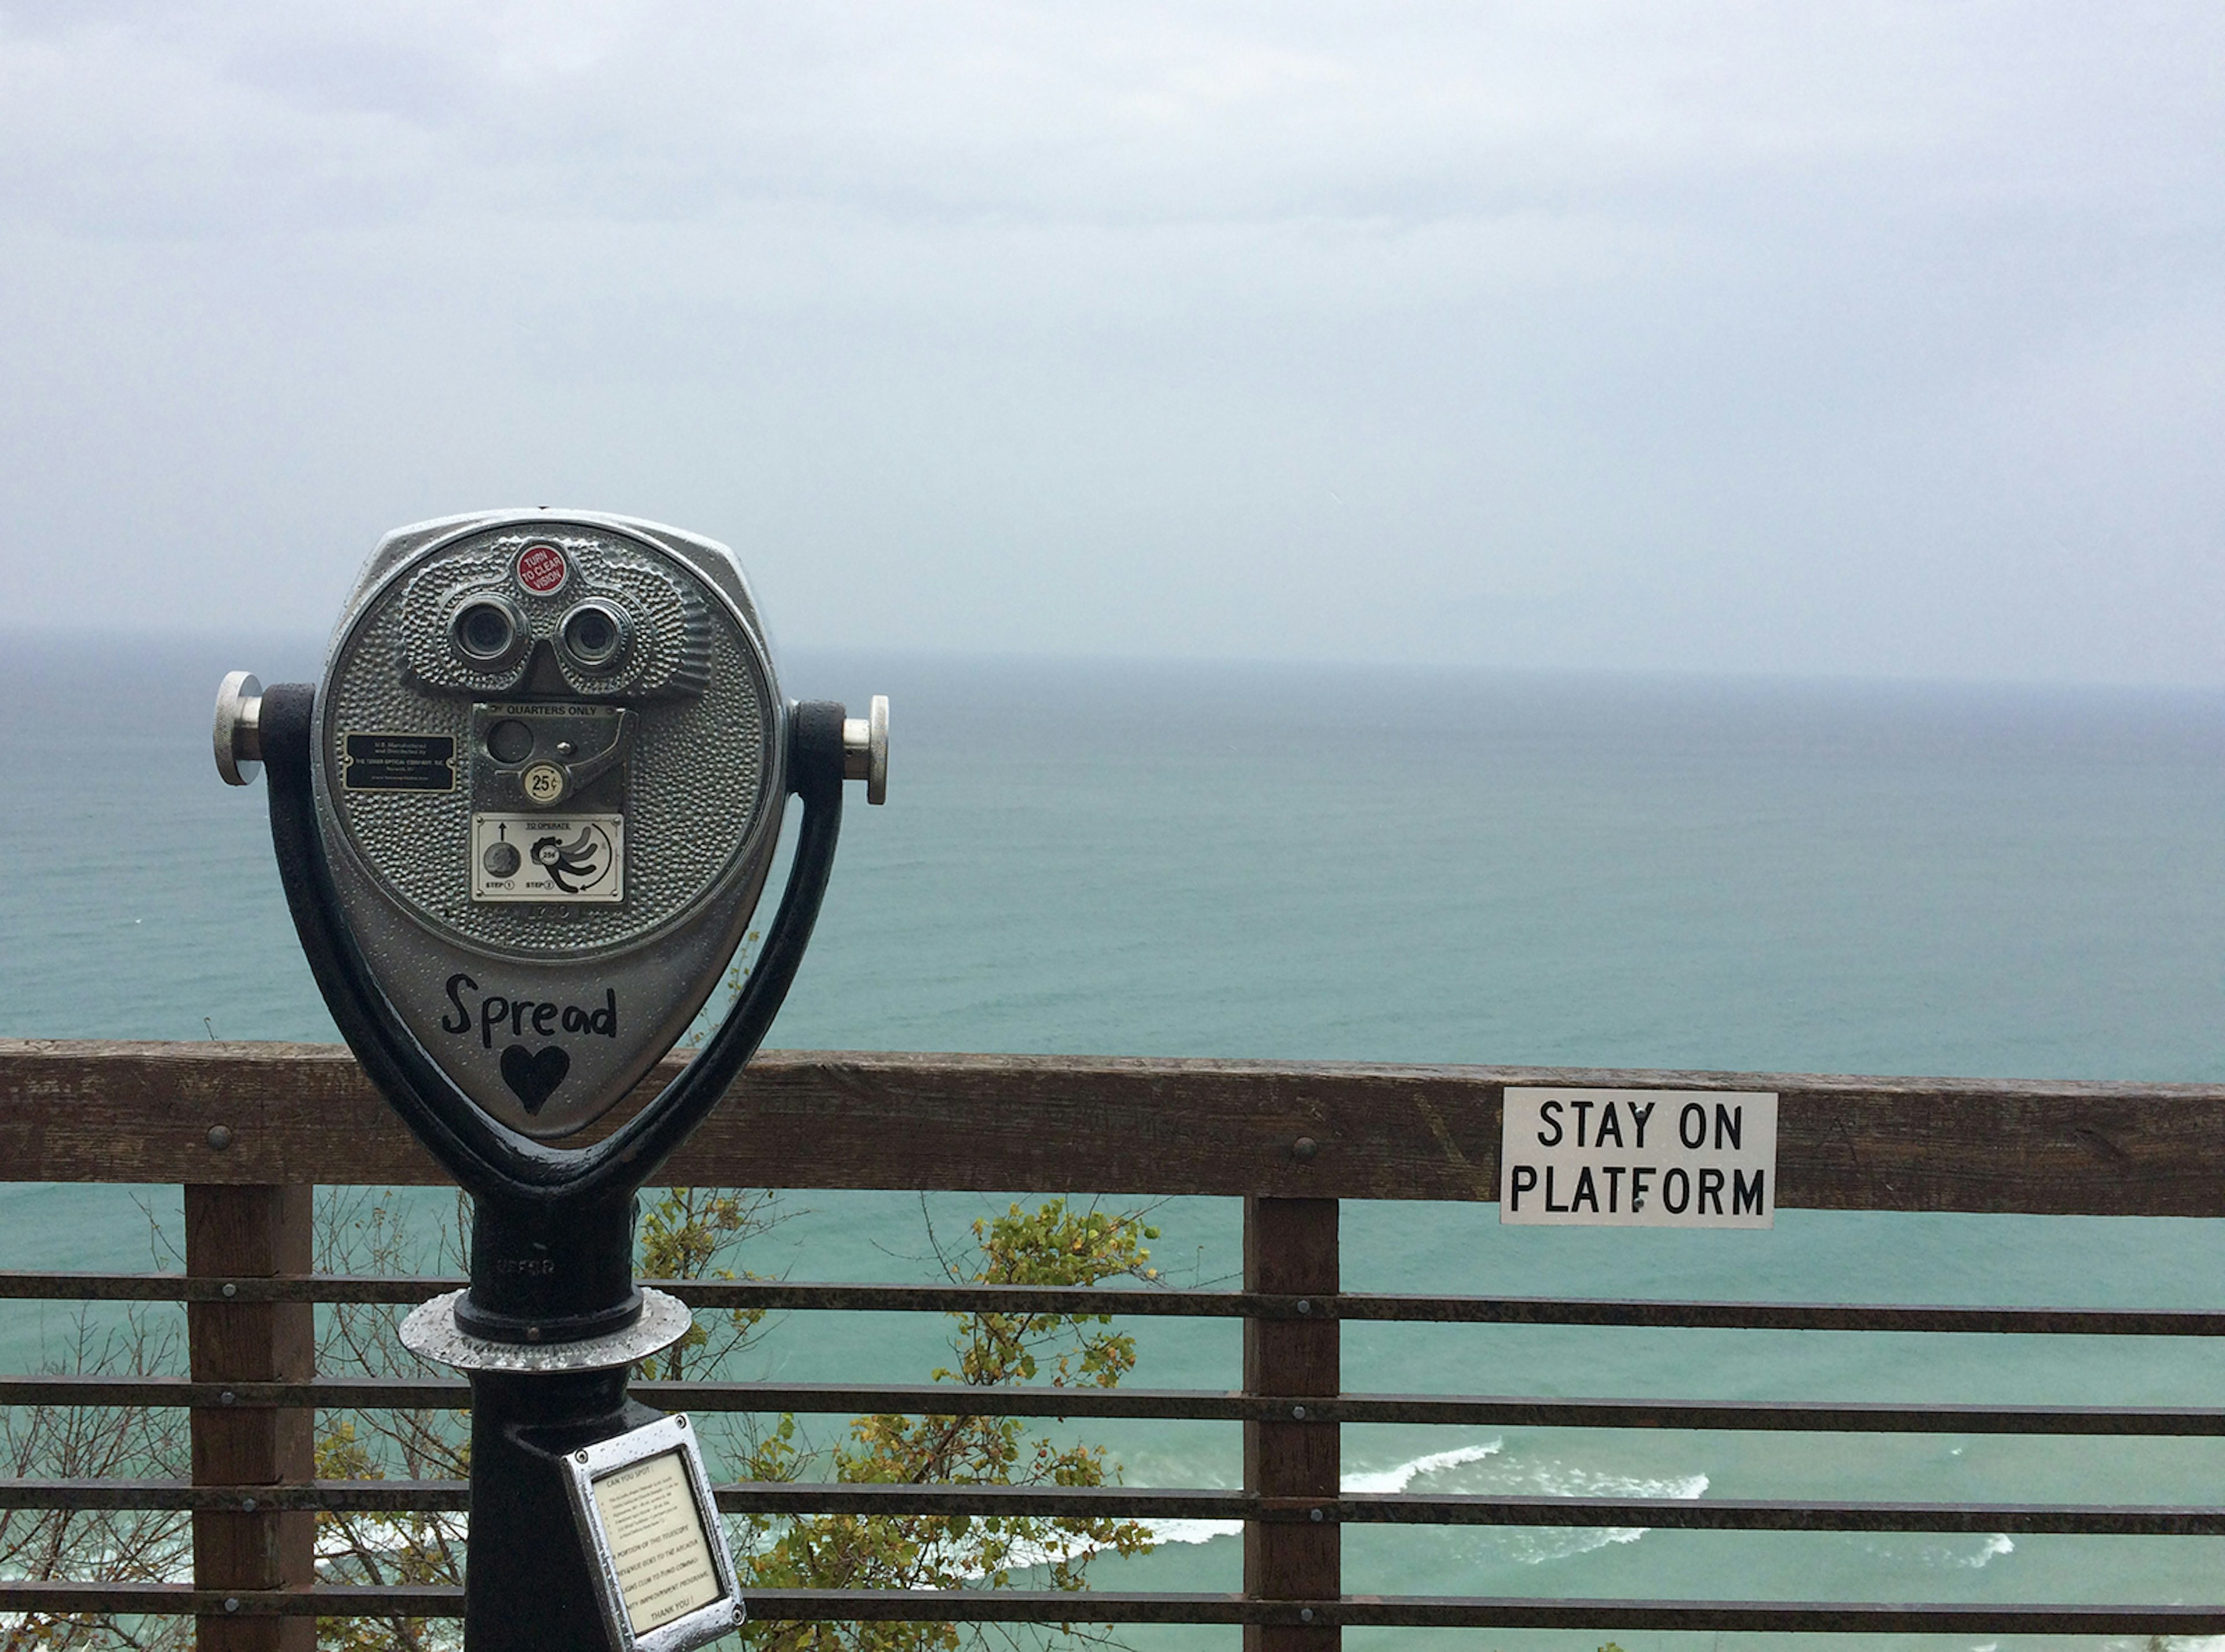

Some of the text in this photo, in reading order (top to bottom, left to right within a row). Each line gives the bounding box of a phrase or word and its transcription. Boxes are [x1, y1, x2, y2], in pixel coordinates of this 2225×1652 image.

[524, 550, 548, 567] TURN
[522, 557, 562, 582] TO CLEAR
[533, 570, 561, 589] VISION
[507, 706, 597, 715] QUARTERS ONLY
[532, 775, 558, 792] 25¢
[442, 973, 617, 1048] Spread
[1537, 1101, 1742, 1150] STAY ON
[1511, 1165, 1764, 1216] PLATFORM
[606, 1479, 621, 1488] CAN
[621, 1474, 634, 1483] YOU
[617, 1545, 641, 1558] PORTION
[650, 1536, 661, 1545] THIS
[665, 1547, 675, 1556] THE
[650, 1607, 675, 1621] THANK
